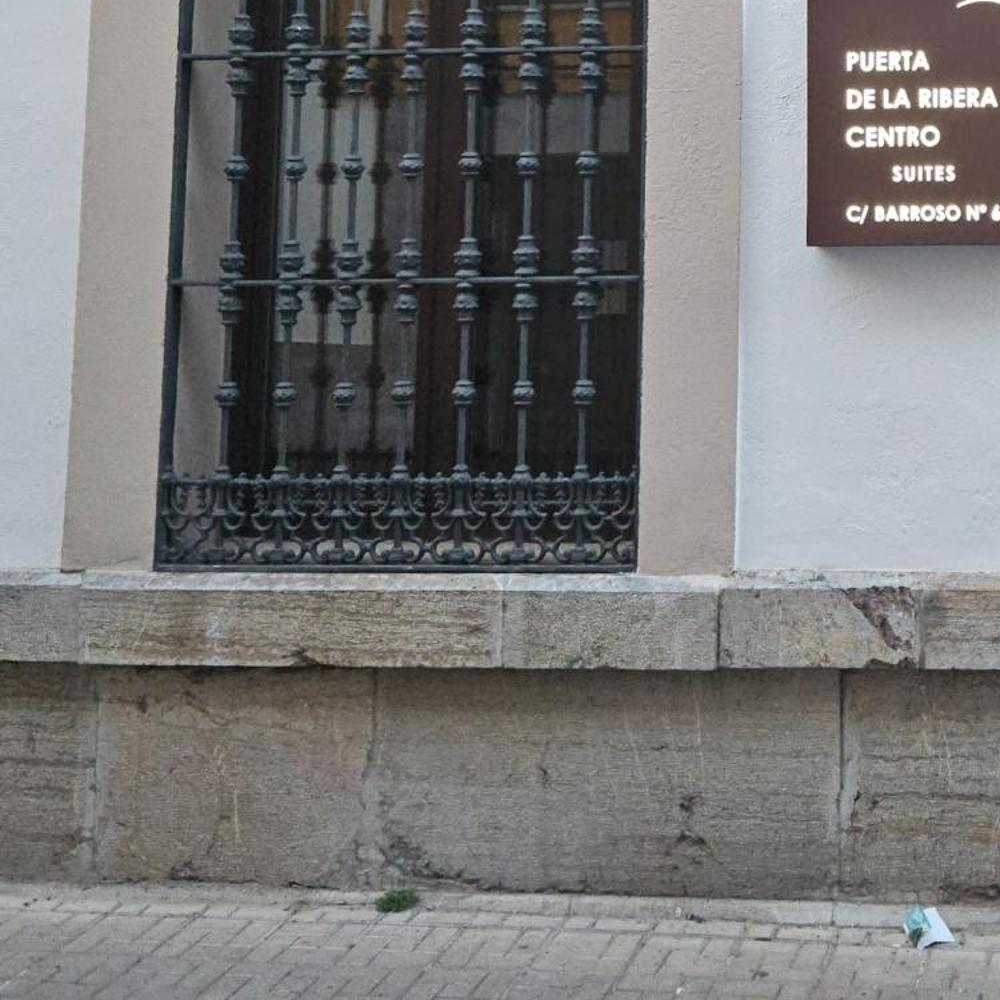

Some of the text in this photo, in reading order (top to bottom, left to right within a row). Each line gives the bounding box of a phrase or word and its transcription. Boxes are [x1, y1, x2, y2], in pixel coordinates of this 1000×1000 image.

[845, 49, 931, 73] PUERTA
[845, 86, 999, 110] DE LA RIBERA
[844, 124, 941, 148] CENTRO
[891, 164, 957, 183] SUITES
[845, 204, 869, 225] C/
[874, 203, 962, 223] BARROSO
